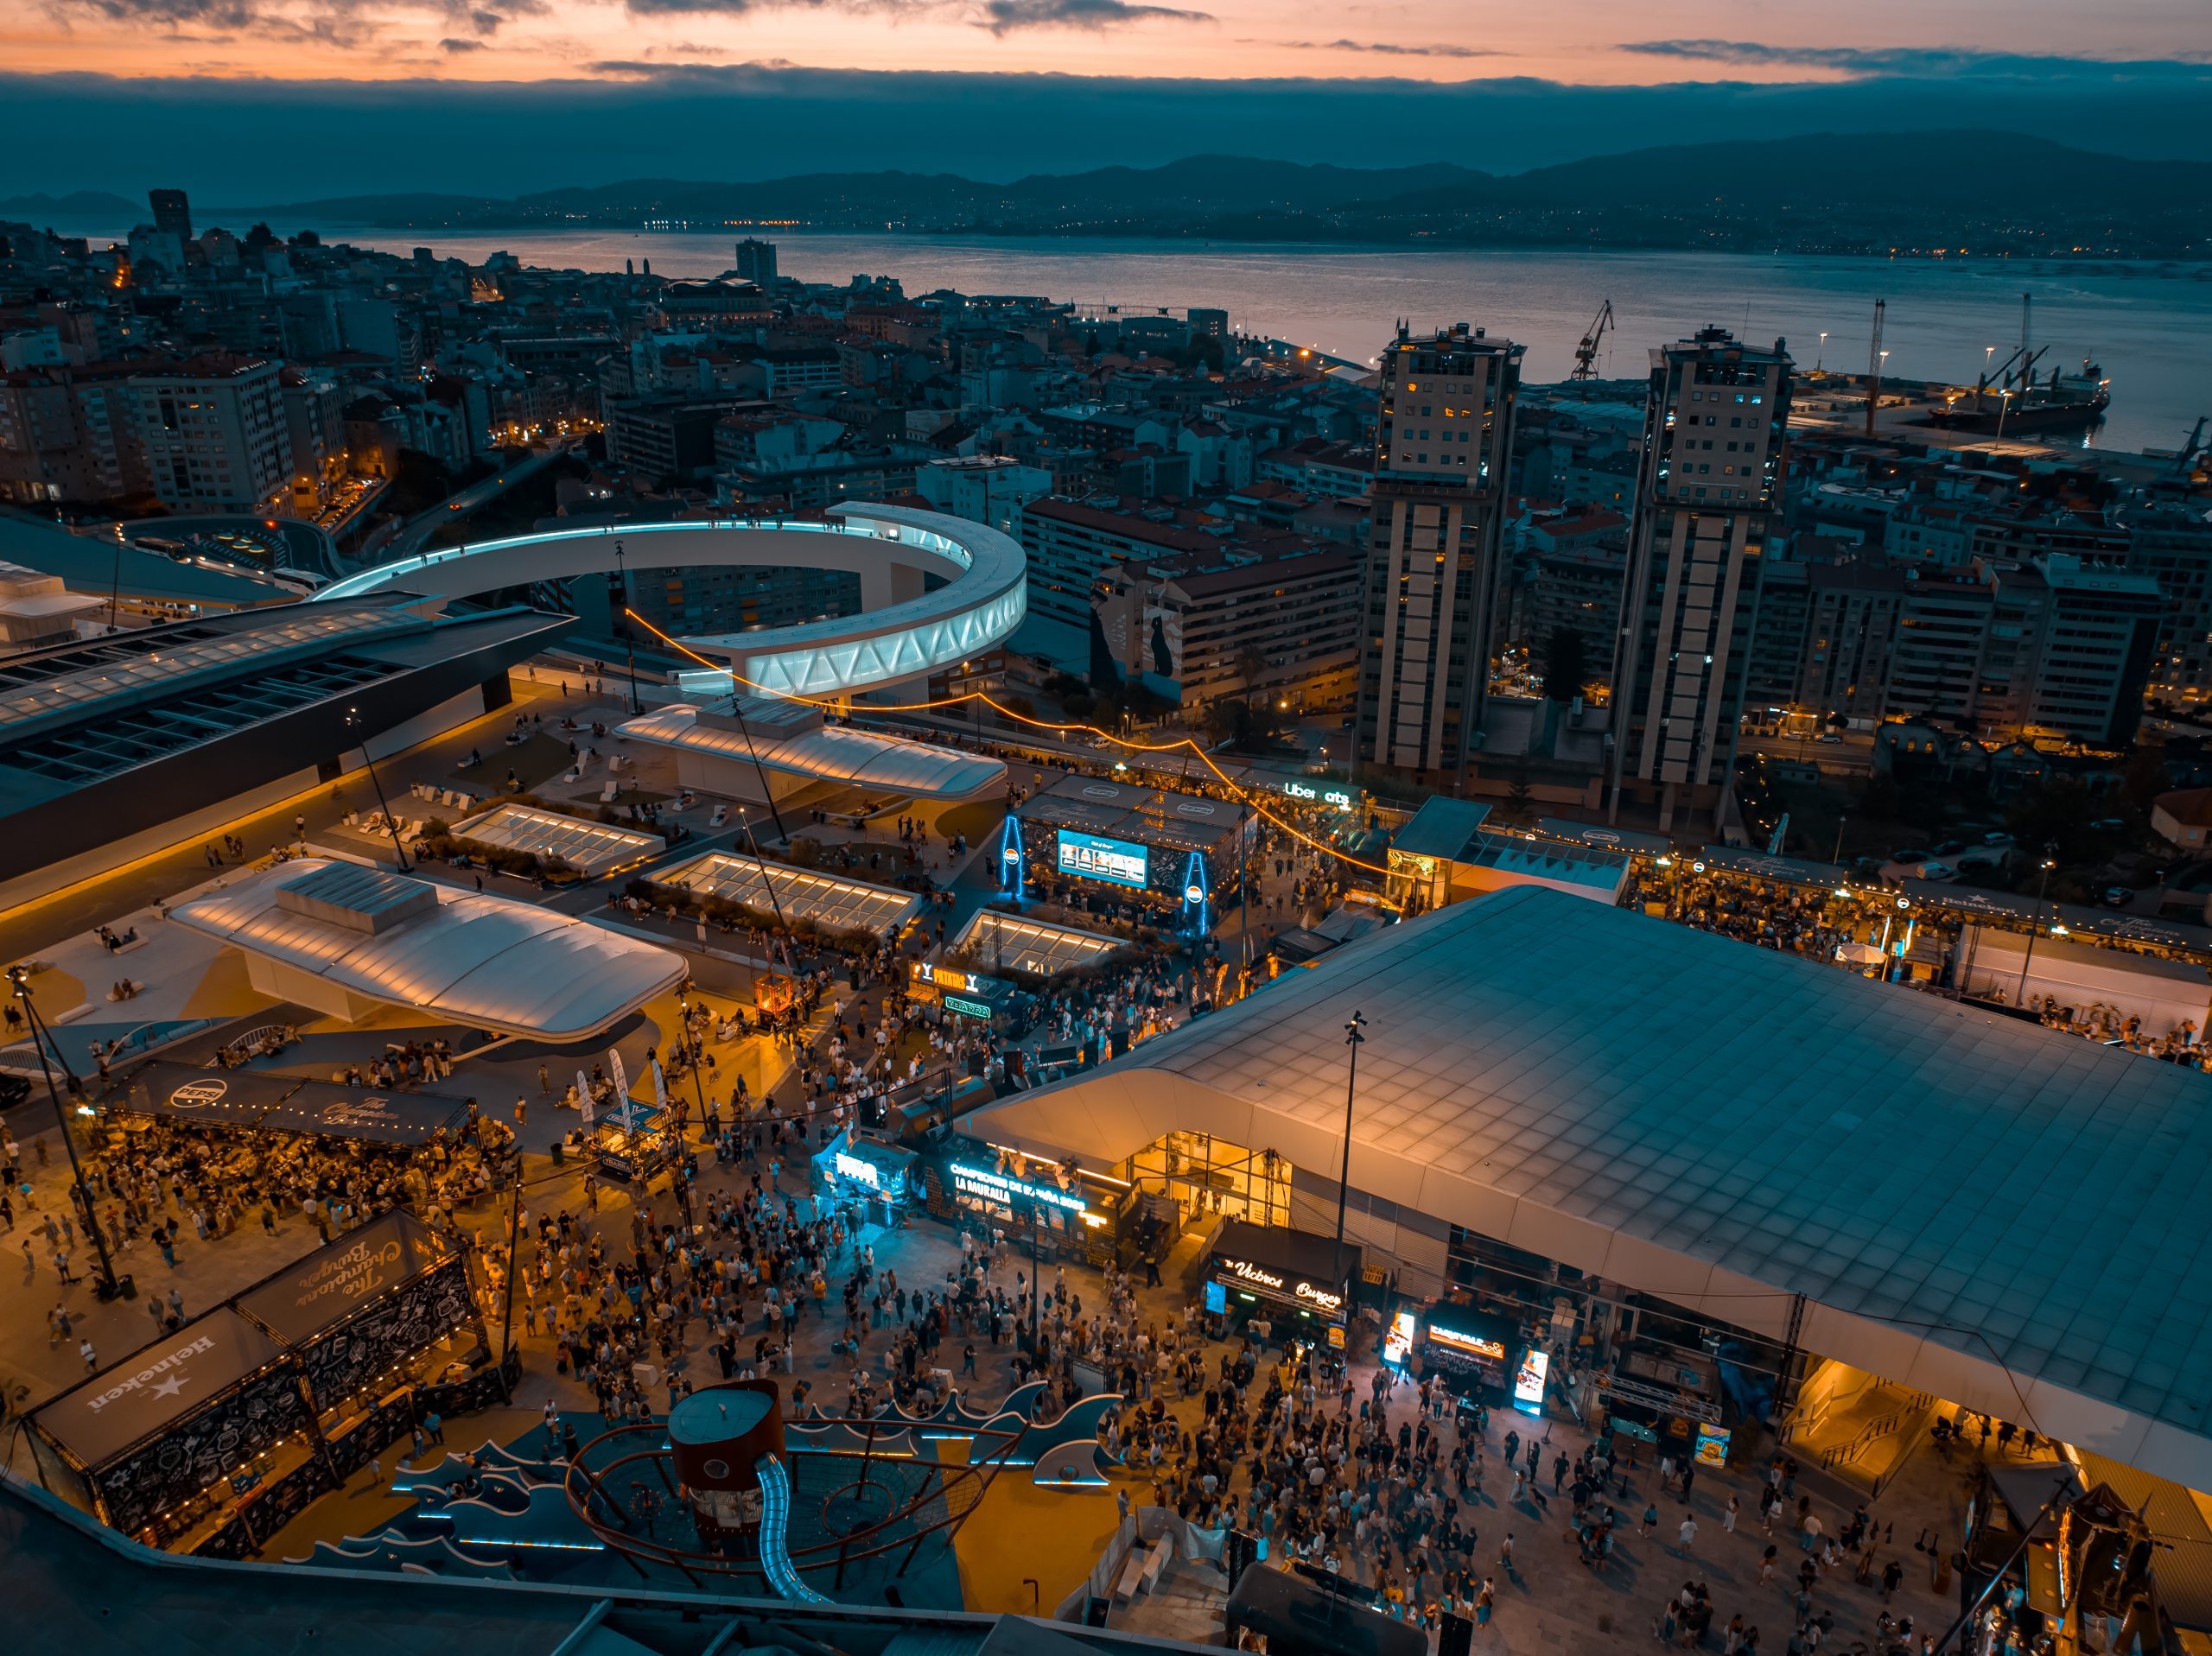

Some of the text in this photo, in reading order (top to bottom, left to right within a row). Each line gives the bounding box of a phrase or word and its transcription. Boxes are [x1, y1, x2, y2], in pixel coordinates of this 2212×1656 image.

[1284, 782, 1315, 799] Uber
[1942, 897, 2017, 914] Heineken
[933, 968, 965, 990] PATATAS
[948, 999, 989, 1017] YBARRA
[177, 1088, 221, 1099] PEPSI
[356, 1096, 390, 1110] The
[323, 1101, 400, 1120] Champions
[604, 1158, 631, 1171] YBARRA
[950, 1164, 1008, 1188] CAMPEONES
[1009, 1180, 1023, 1193] DE
[956, 1176, 1010, 1203] LA MURALLA
[296, 1240, 402, 1307] Champions
[298, 1241, 371, 1288] Burger
[342, 1267, 384, 1298] The
[1235, 1261, 1283, 1288] Vicbros
[1295, 1283, 1341, 1309] Burger
[87, 1336, 216, 1410] Heineken
